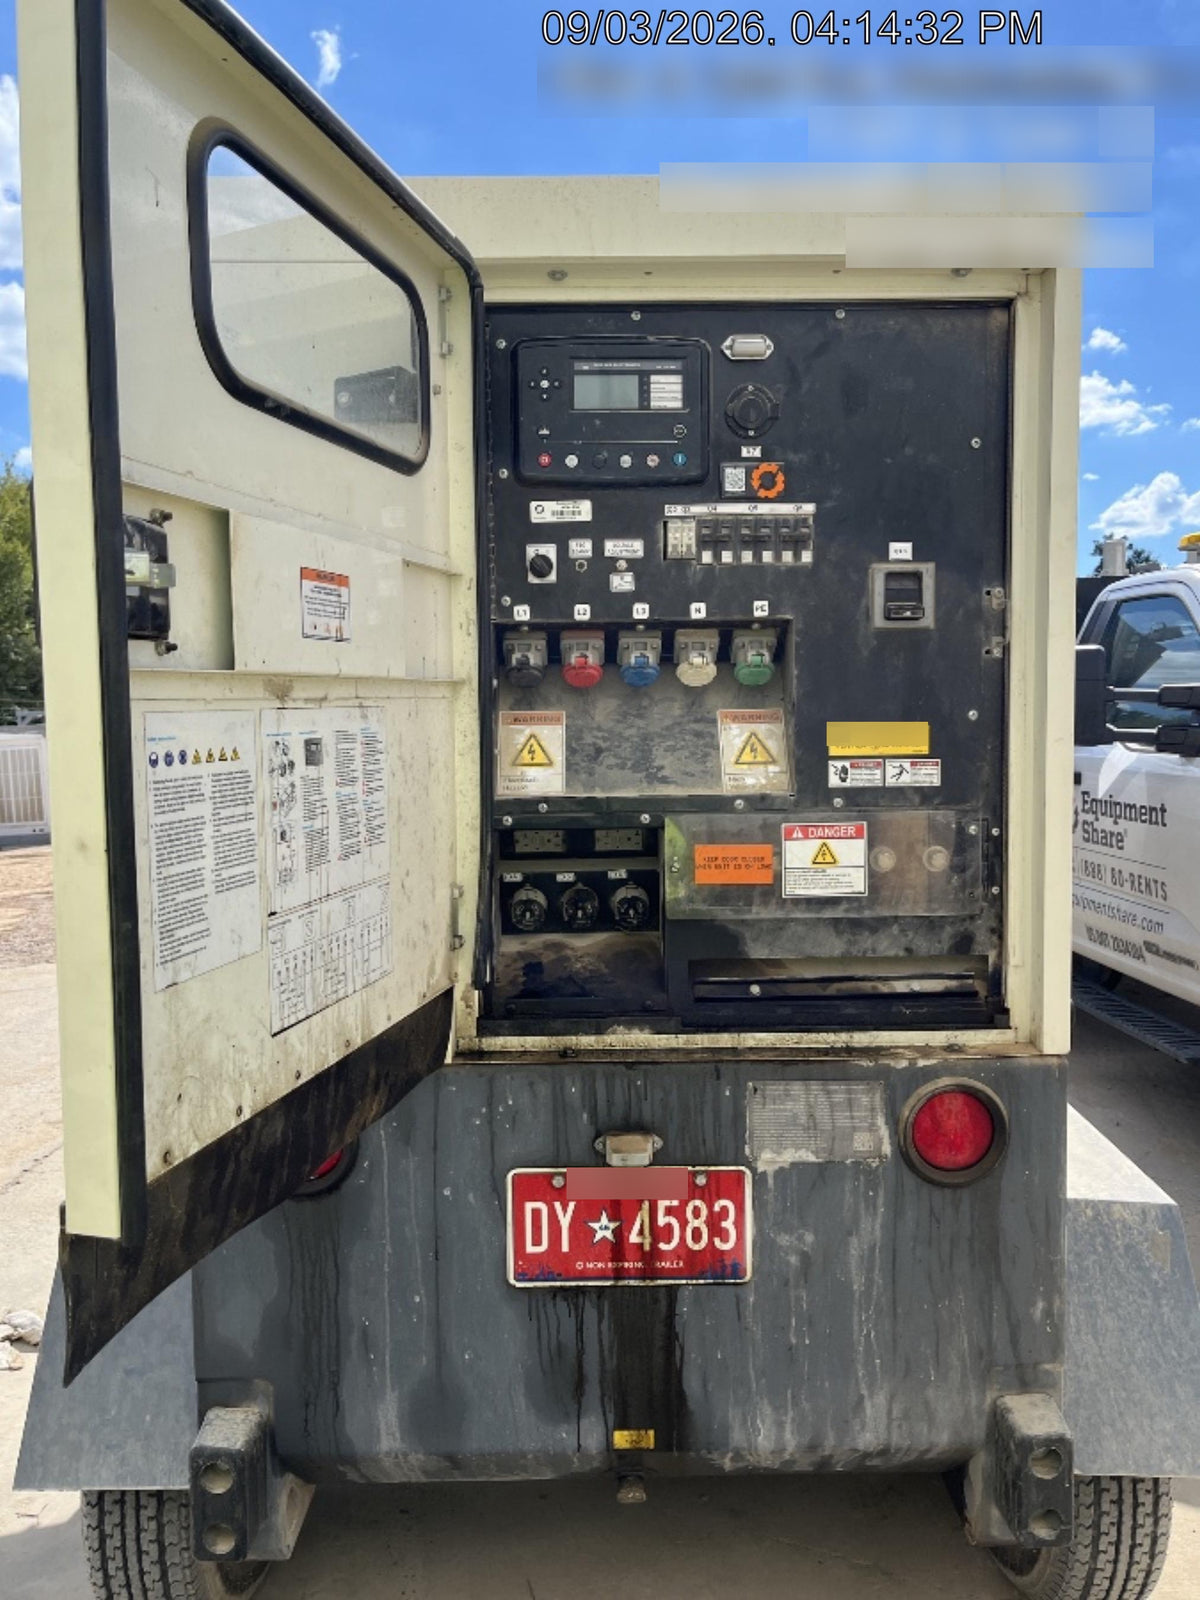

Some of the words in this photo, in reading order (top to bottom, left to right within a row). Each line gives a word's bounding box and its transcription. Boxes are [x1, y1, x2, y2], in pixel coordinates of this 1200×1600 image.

[577, 608, 588, 617] L2
[1081, 790, 1168, 828] Equipment
[808, 826, 856, 838] DANGER
[524, 1200, 577, 1254] DY
[628, 1199, 738, 1252] 4583
